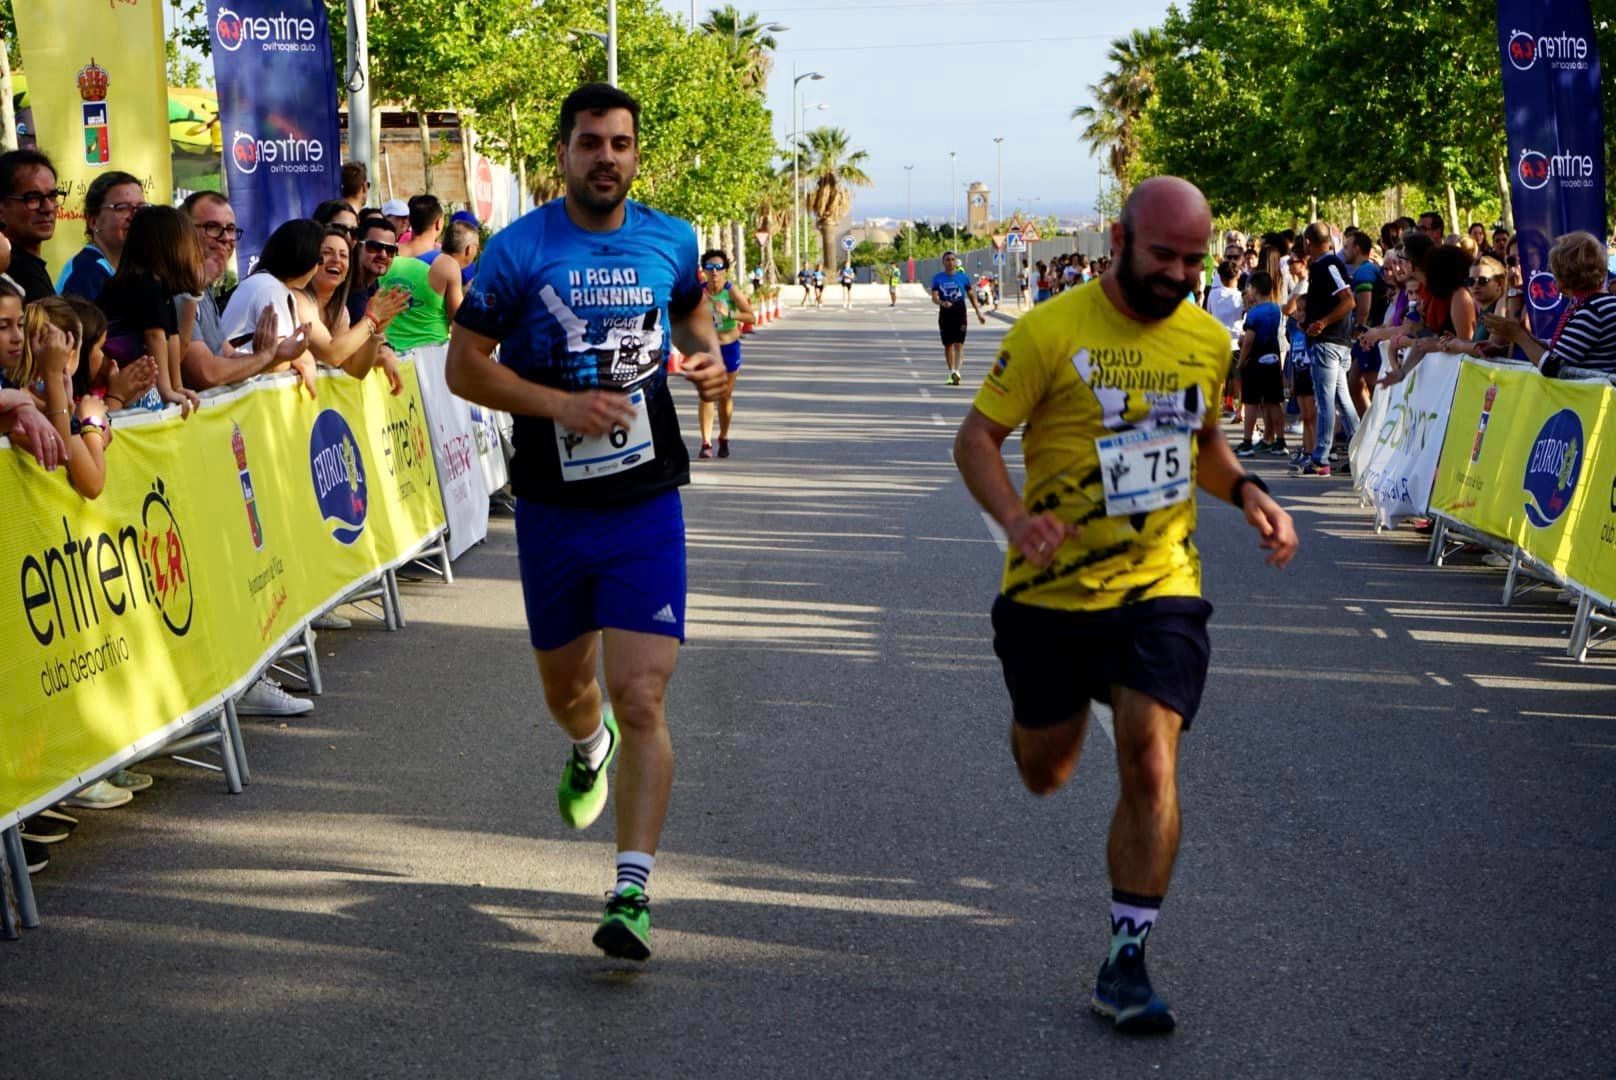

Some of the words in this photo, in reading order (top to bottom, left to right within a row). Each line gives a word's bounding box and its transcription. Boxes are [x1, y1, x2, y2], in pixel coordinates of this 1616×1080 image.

[586, 267, 637, 286] ROAD
[570, 287, 654, 307] RUNNING
[1088, 348, 1143, 368] ROAD
[1087, 369, 1179, 392] RUNNING
[313, 442, 363, 499] EUROSL
[1143, 445, 1180, 482] 75
[1530, 438, 1578, 488] EUROSL
[21, 515, 151, 646] entren
[41, 661, 69, 697] club
[70, 634, 130, 685] deportivo
